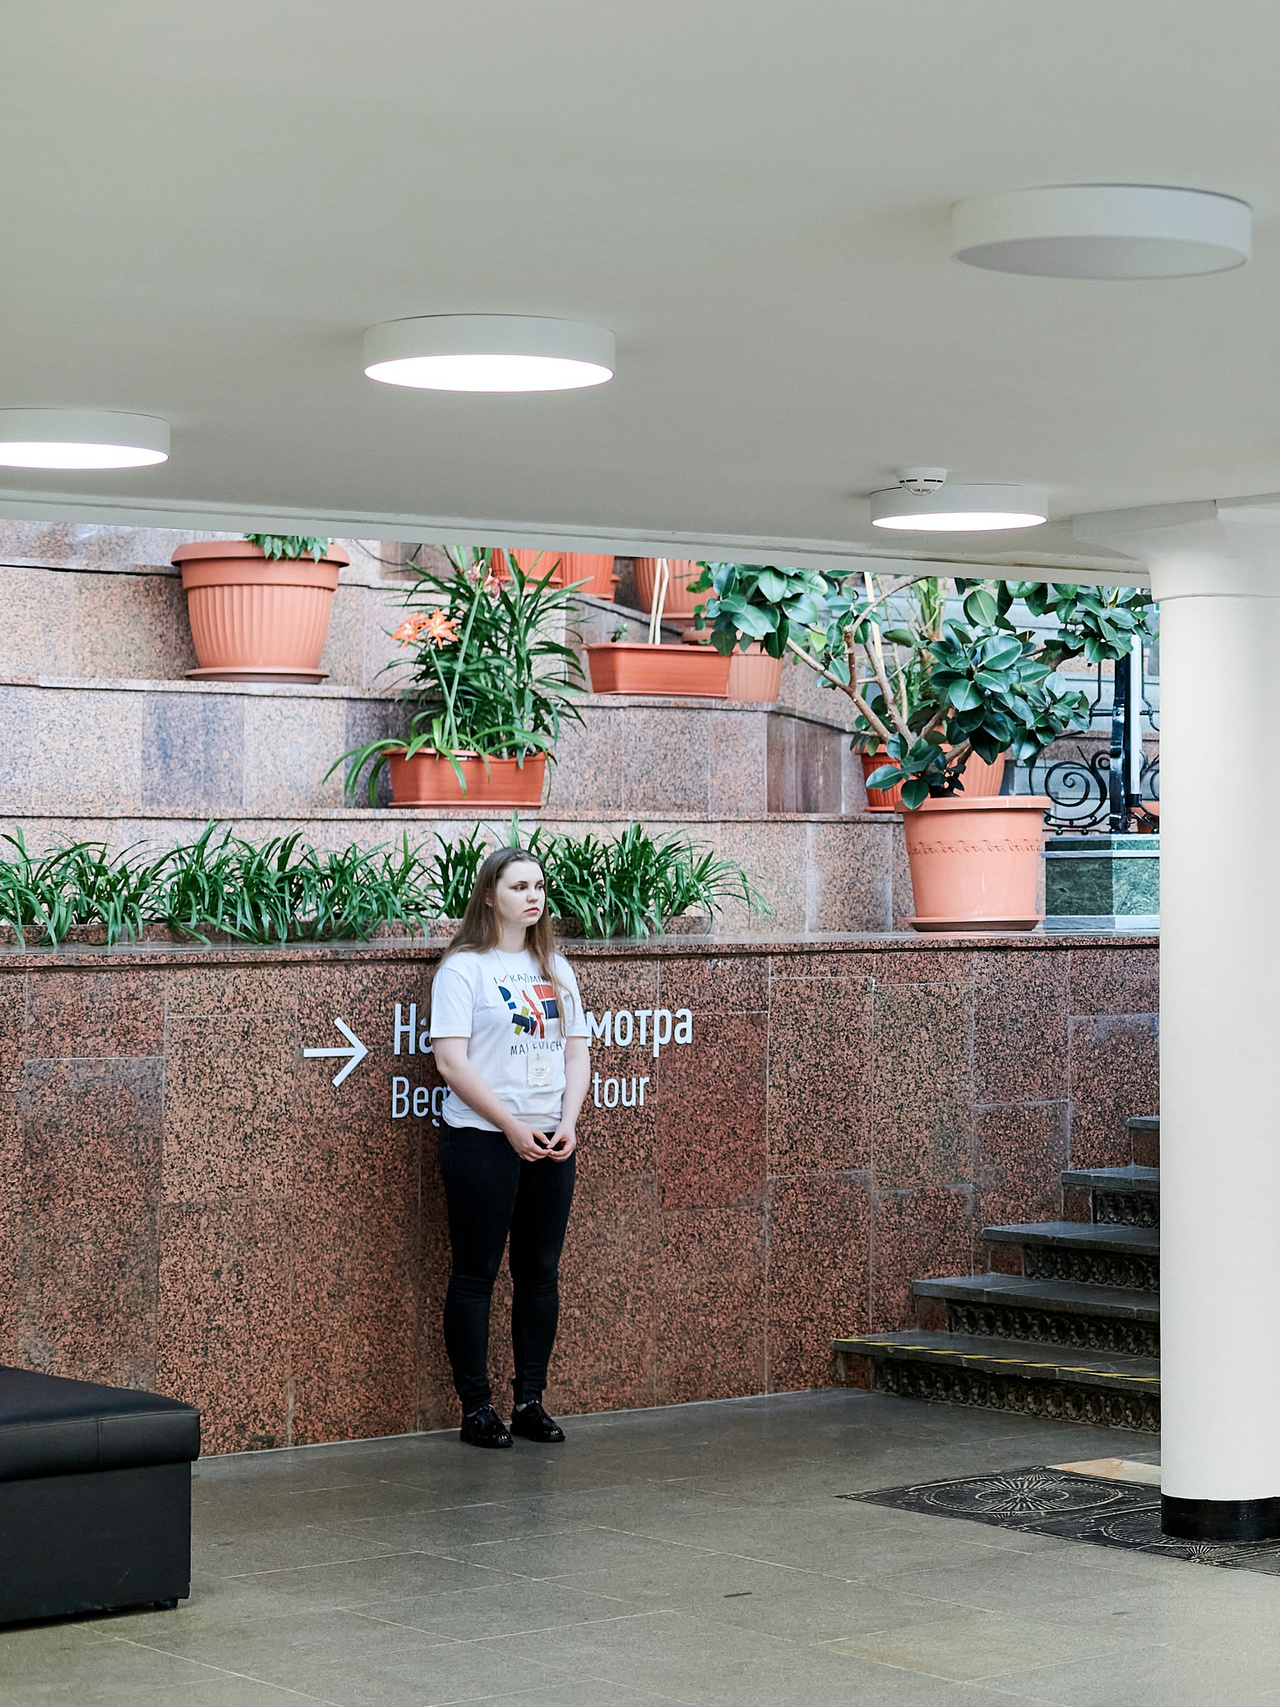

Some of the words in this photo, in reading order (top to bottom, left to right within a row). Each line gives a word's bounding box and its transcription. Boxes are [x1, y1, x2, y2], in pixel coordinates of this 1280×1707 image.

[586, 1007, 693, 1059] мотра
[391, 1075, 448, 1128] Beg
[592, 1071, 650, 1109] tour
